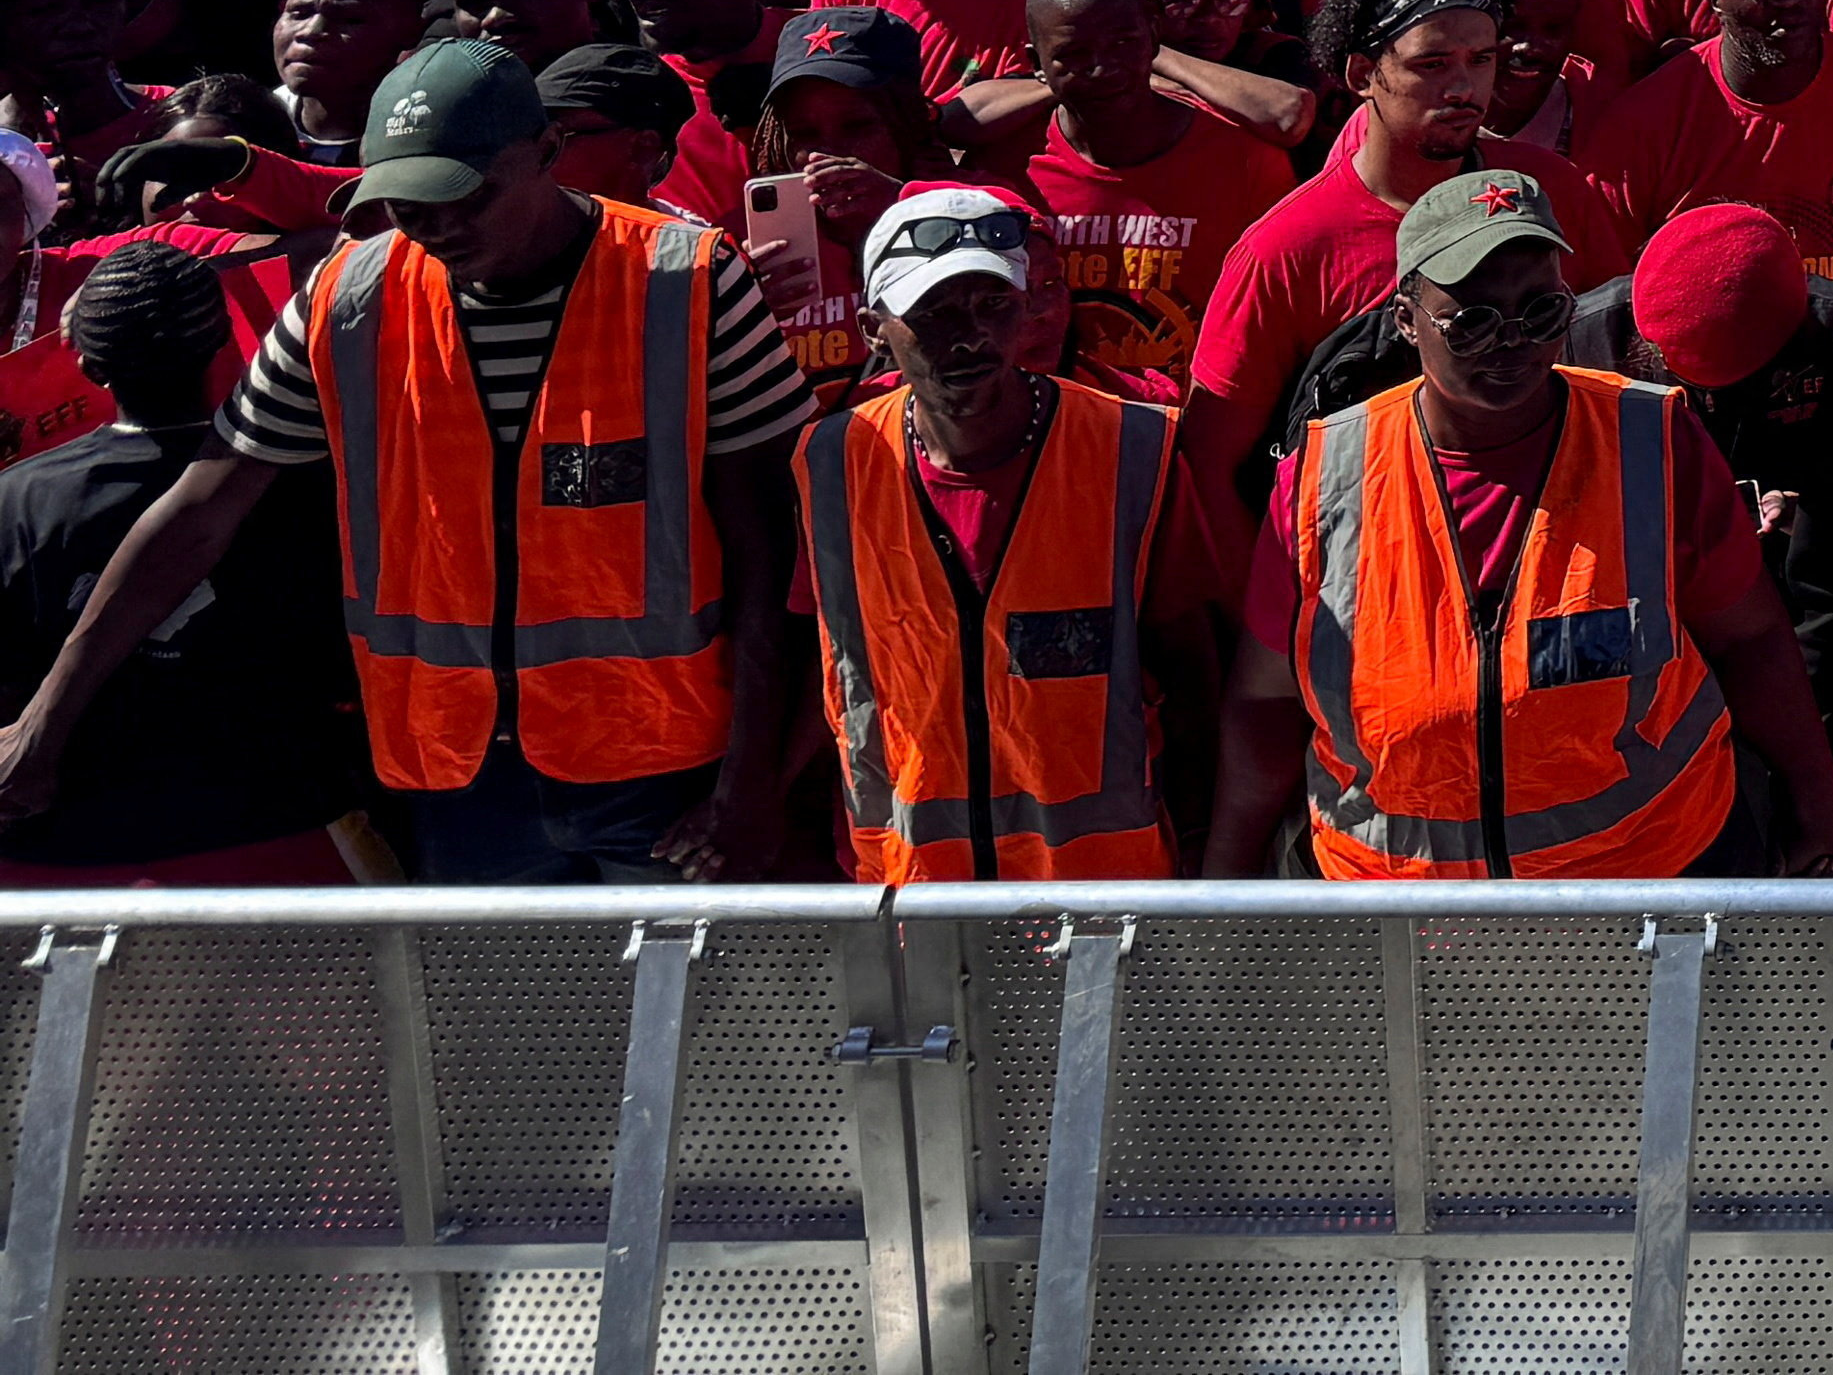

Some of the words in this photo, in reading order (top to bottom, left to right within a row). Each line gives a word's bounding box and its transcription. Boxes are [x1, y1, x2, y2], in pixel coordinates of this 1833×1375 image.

[1117, 214, 1198, 248] WEST
[1118, 246, 1183, 291] EFF
[787, 328, 849, 369] ote
[36, 395, 92, 434] EFF
